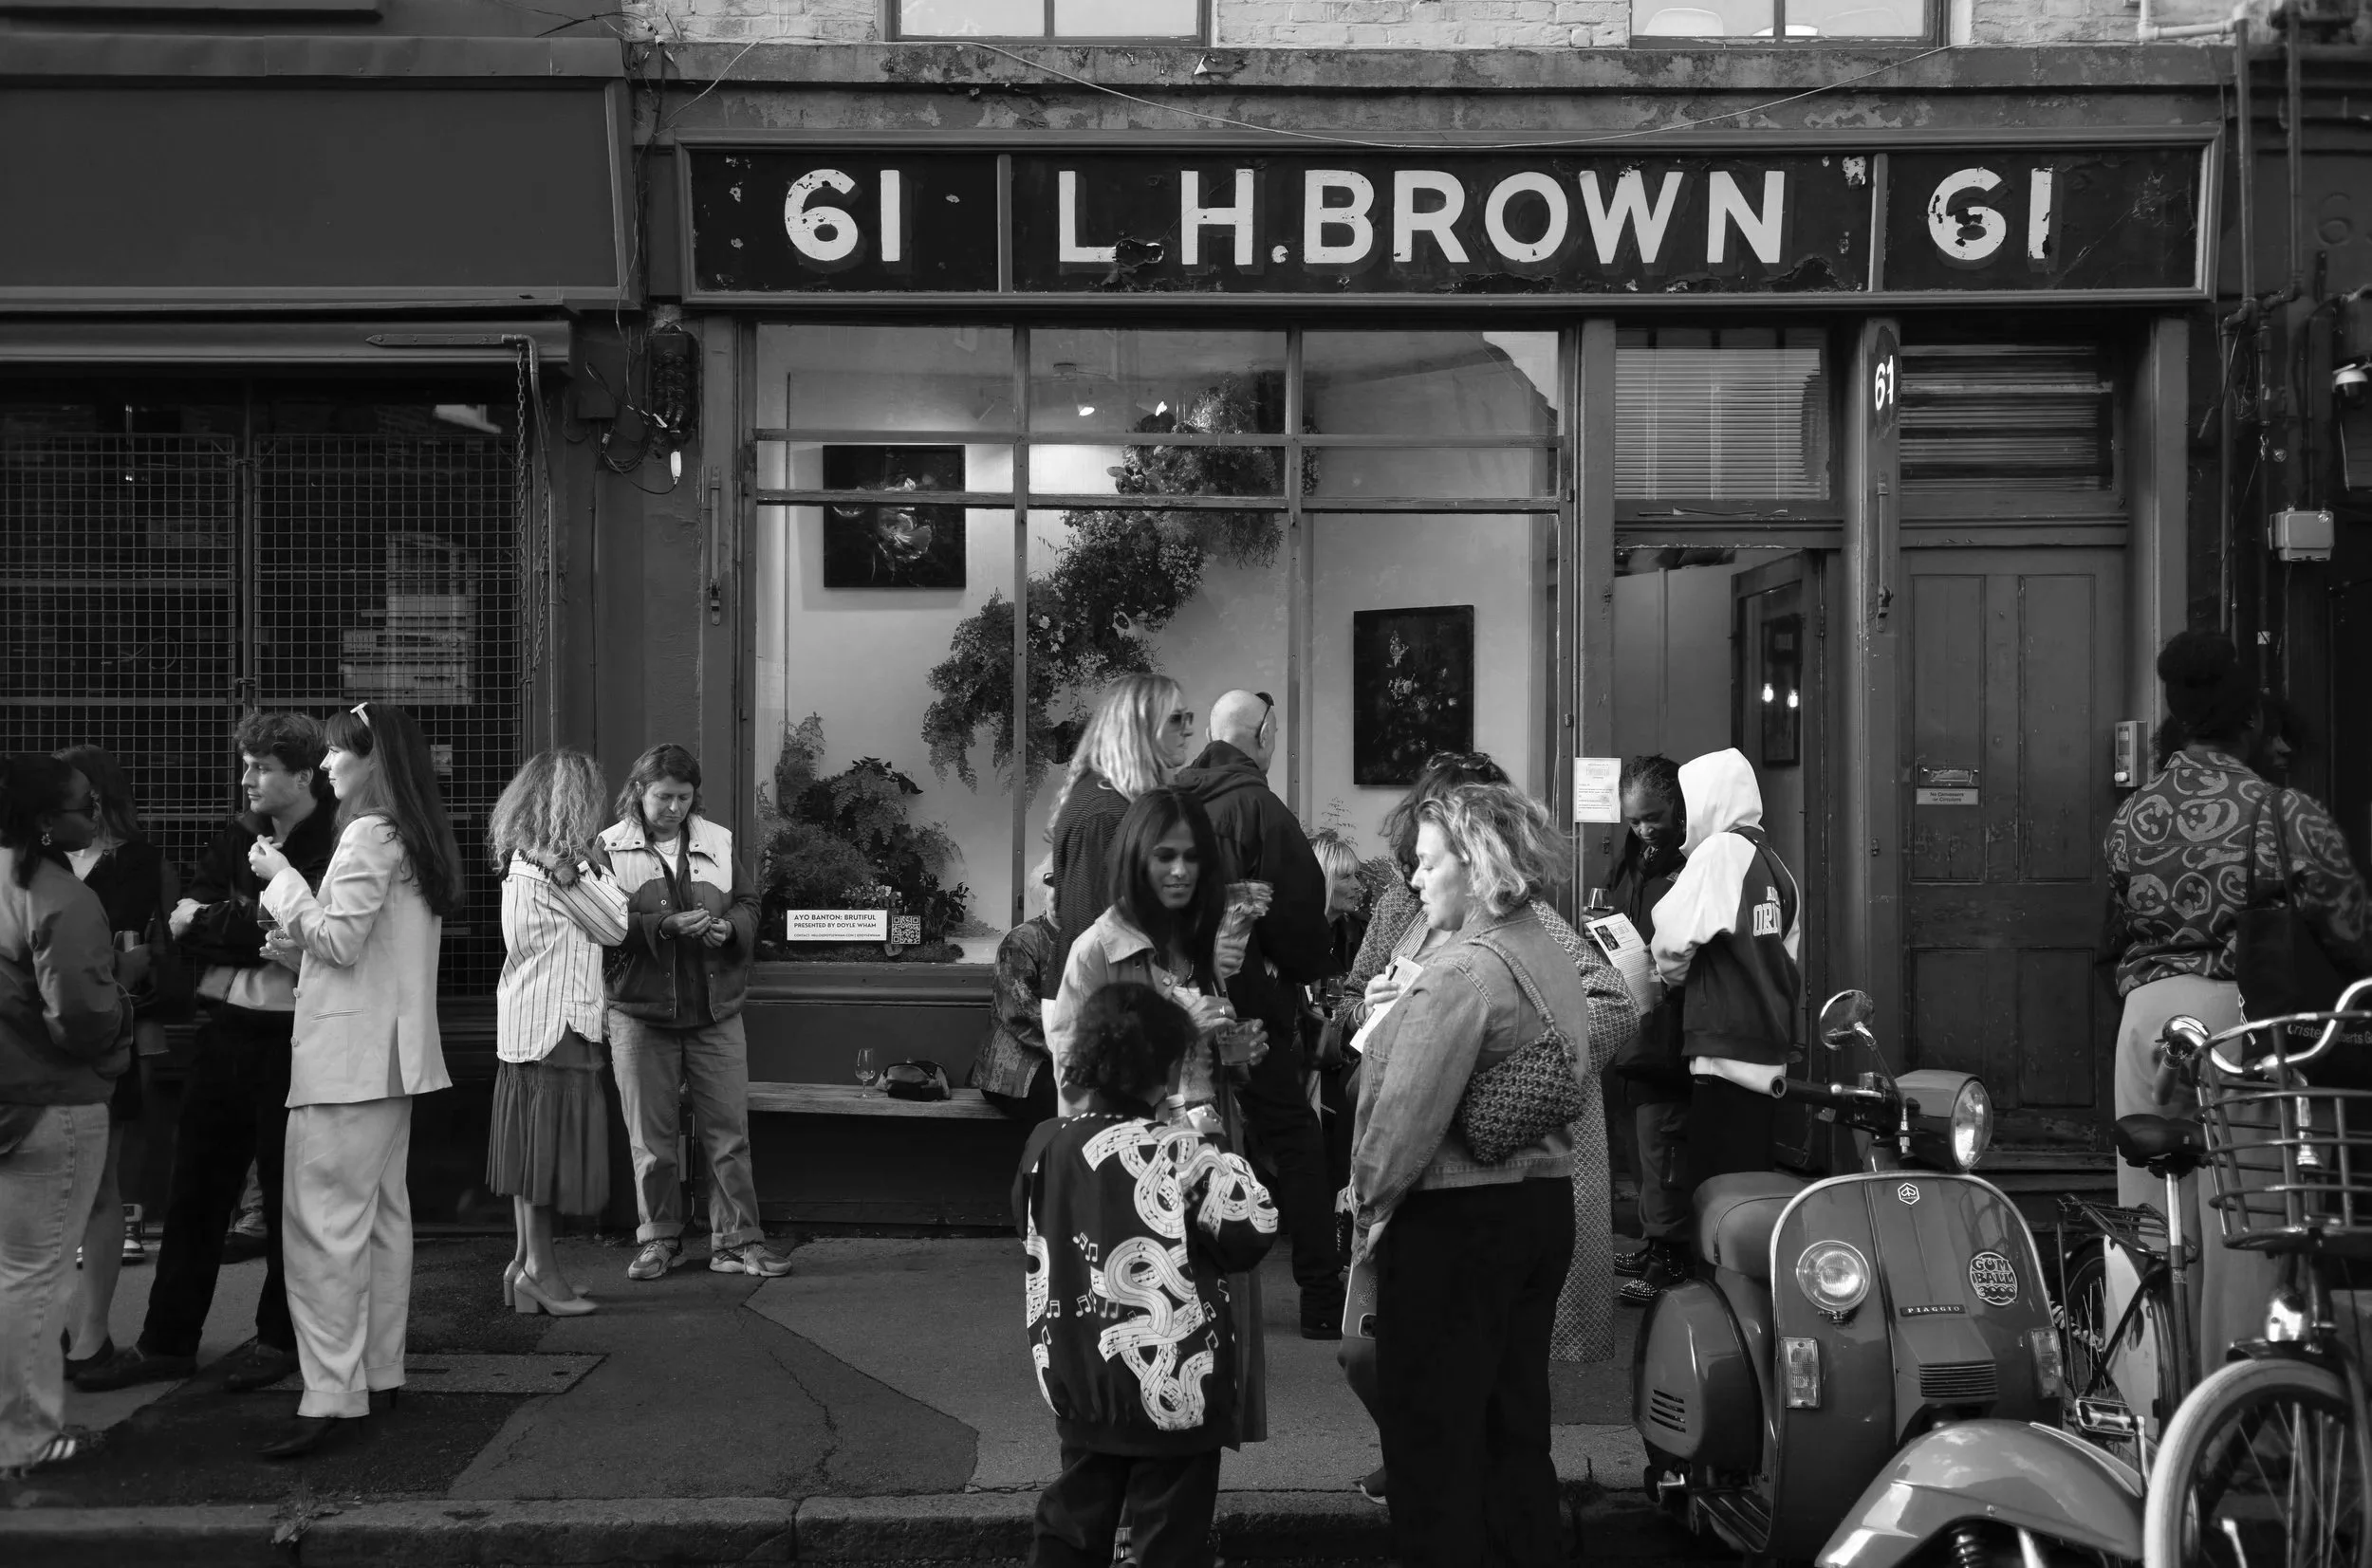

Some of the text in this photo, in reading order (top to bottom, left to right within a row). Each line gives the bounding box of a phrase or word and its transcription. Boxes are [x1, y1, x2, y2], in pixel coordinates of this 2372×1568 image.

[784, 168, 901, 262] 61
[1928, 167, 2053, 262] 61
[2314, 192, 2372, 247] 6
[1875, 355, 1895, 411] 61
[2287, 1024, 2326, 1040] Criste
[1972, 1258, 2010, 1272] GUM
[1907, 1305, 1961, 1314] PIAGGIO
[1977, 1284, 2016, 1300] 3000
